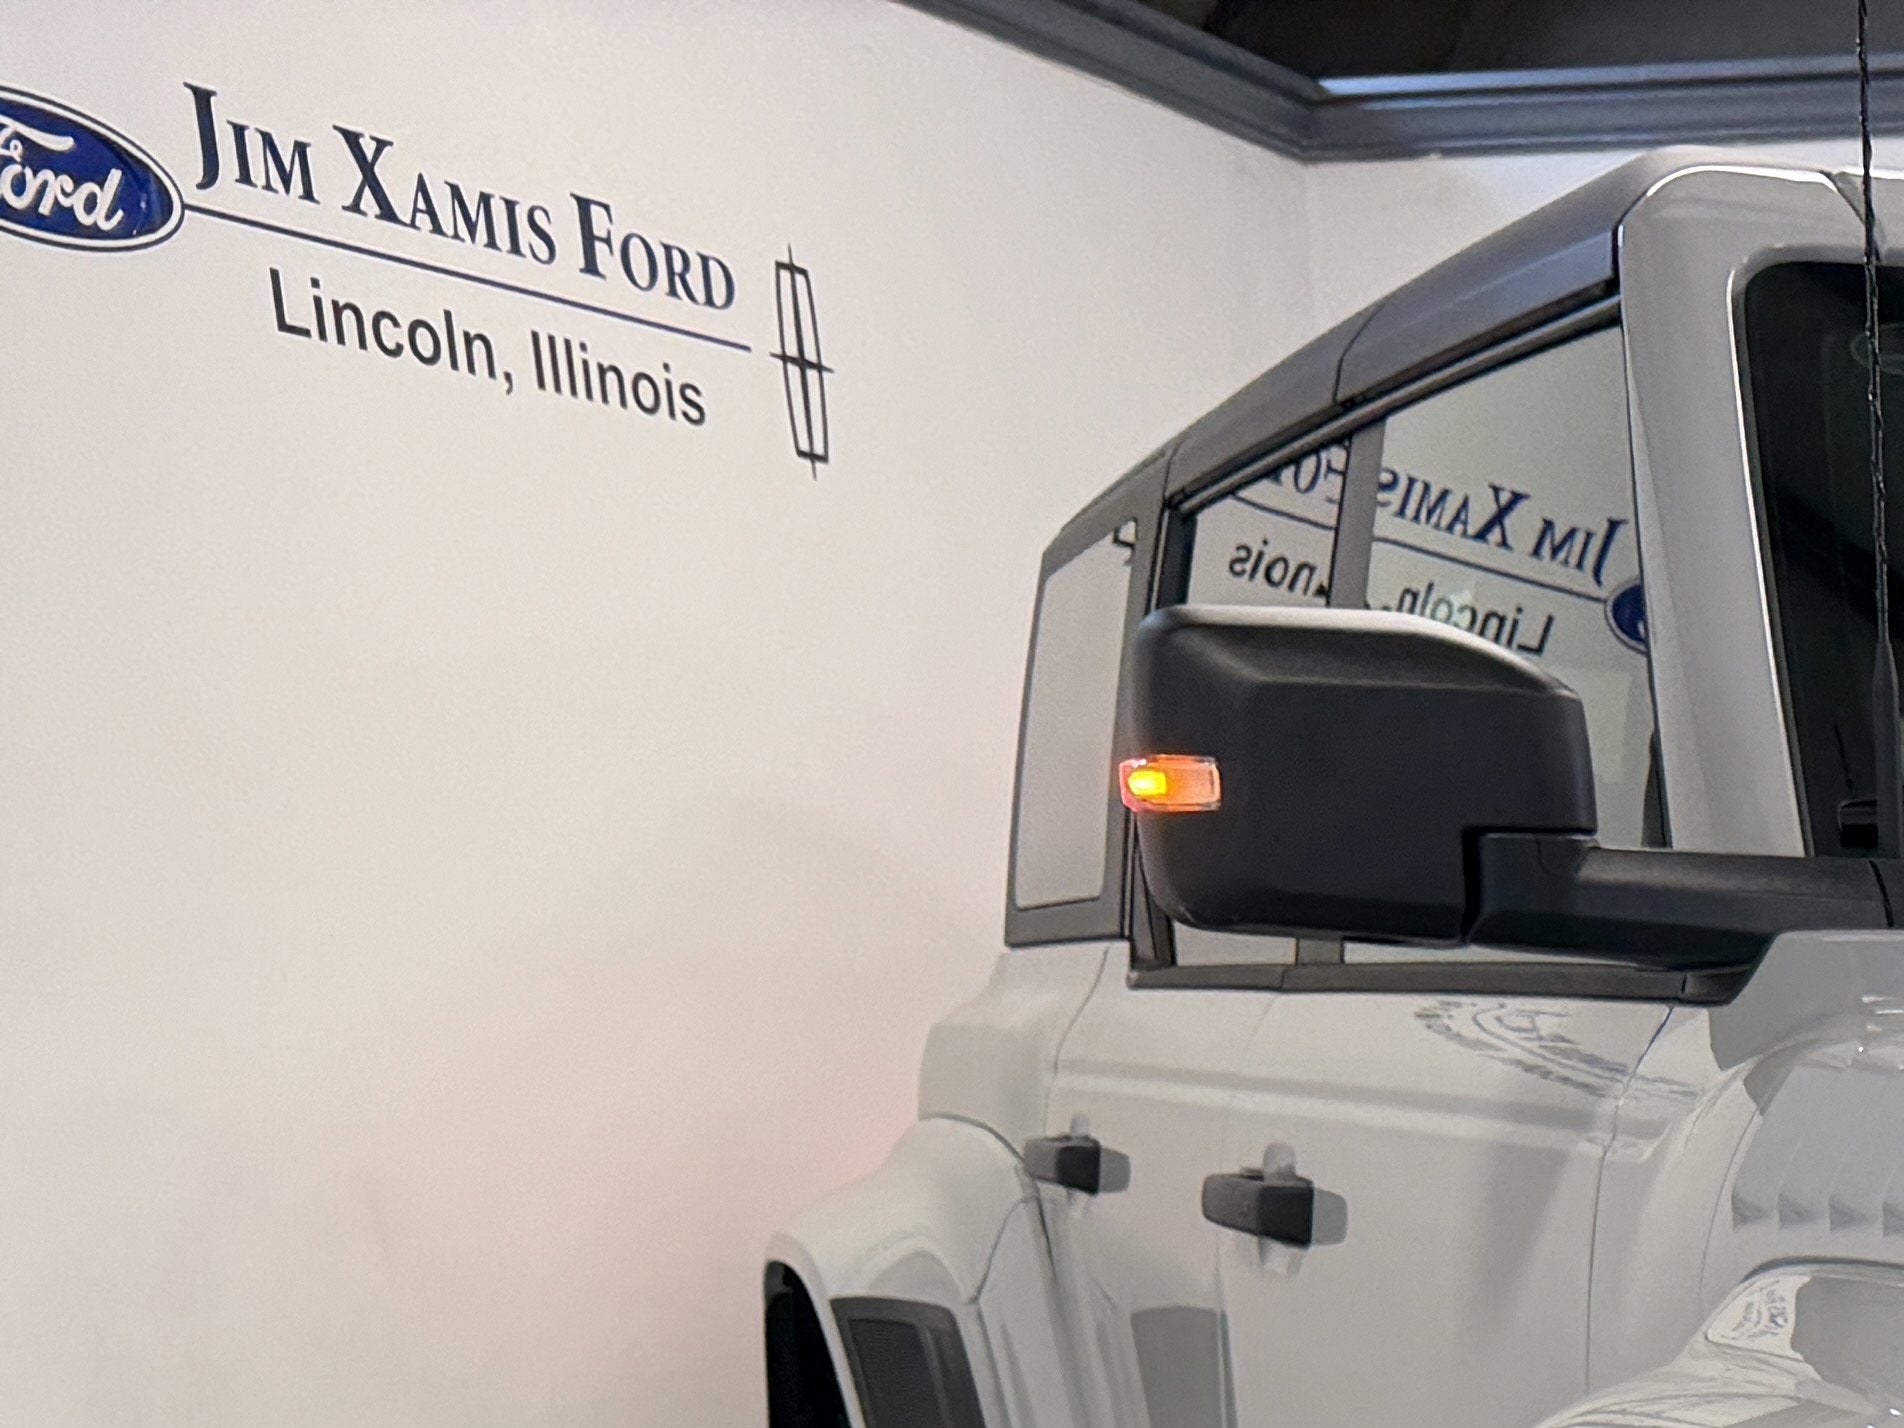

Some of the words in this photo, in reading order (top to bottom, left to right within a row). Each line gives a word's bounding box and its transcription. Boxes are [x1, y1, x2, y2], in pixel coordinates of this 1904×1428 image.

[184, 82, 320, 204] JIM
[332, 125, 557, 265] XAMIS
[570, 193, 735, 311] FORD
[269, 267, 515, 395] Lincoln,
[531, 330, 707, 427] Illinois
